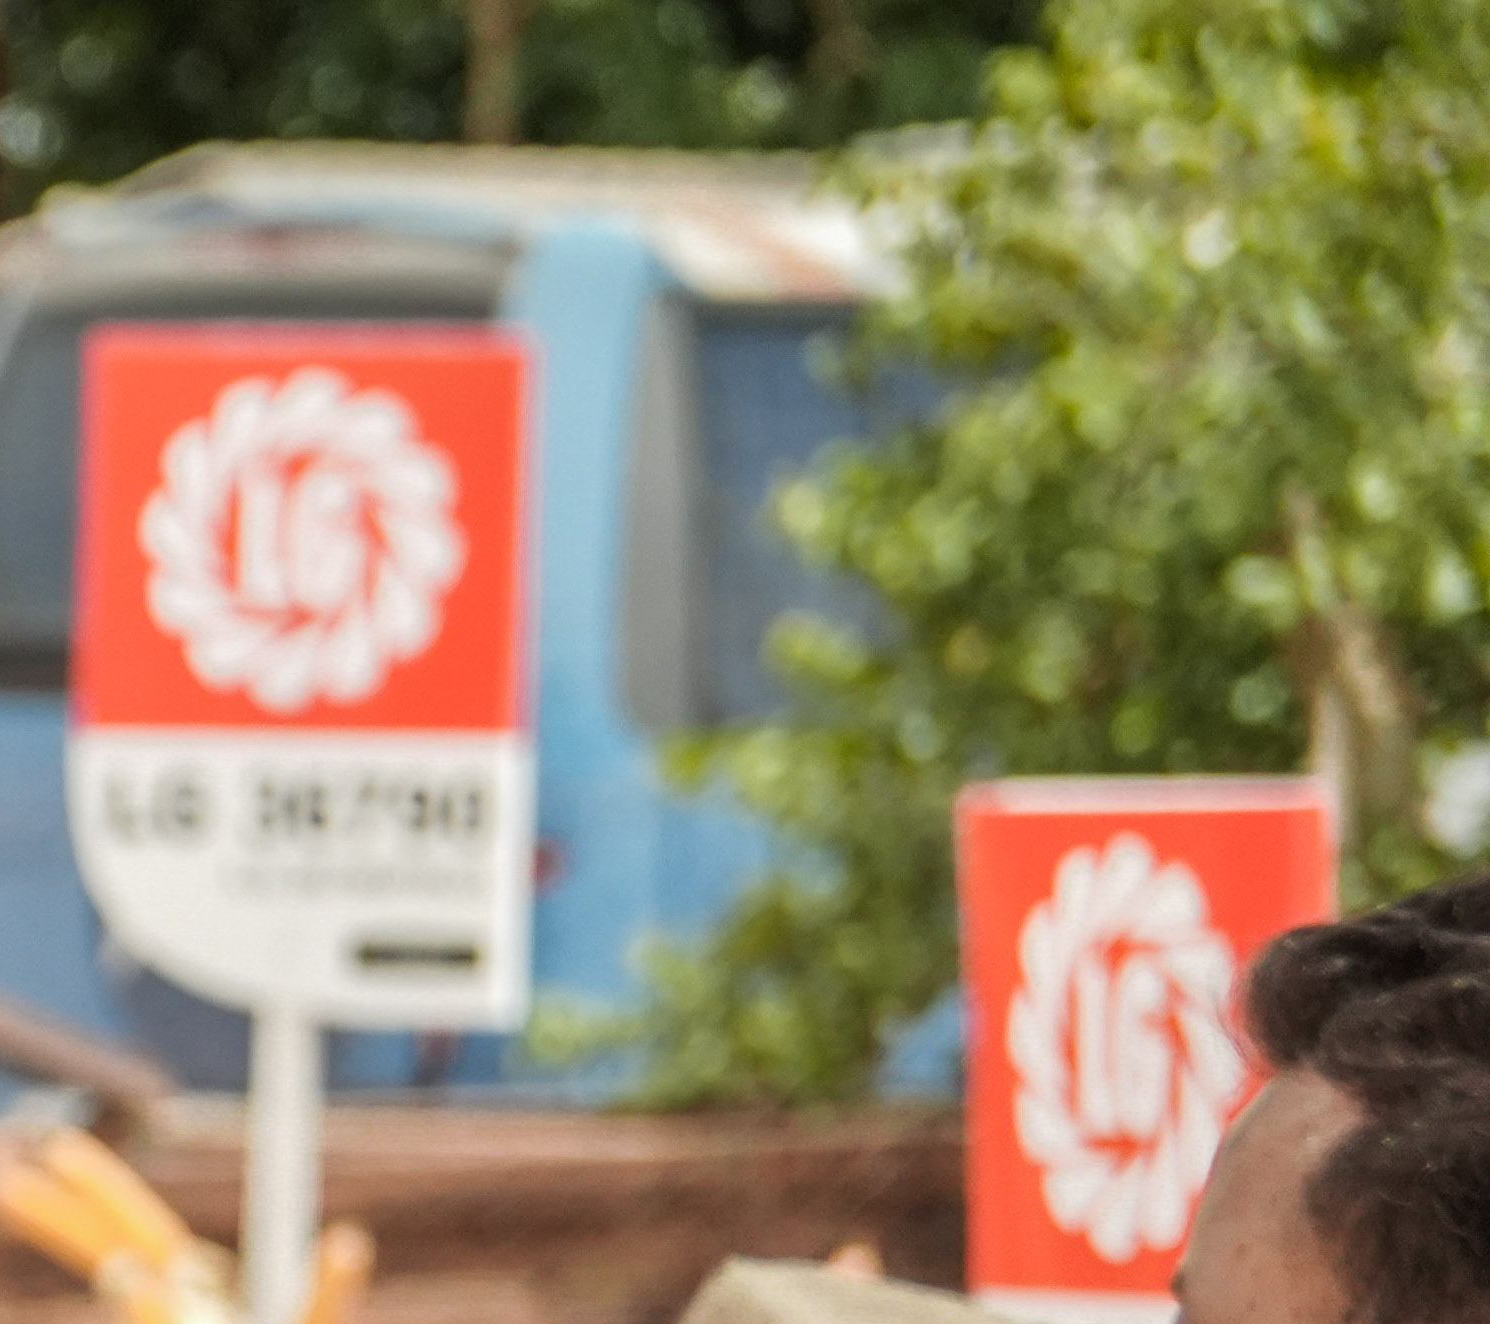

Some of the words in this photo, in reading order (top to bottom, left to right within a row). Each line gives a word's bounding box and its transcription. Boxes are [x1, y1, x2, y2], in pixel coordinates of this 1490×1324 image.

[236, 453, 358, 612] LG
[106, 770, 211, 841] LG
[1073, 953, 1177, 1139] LG
